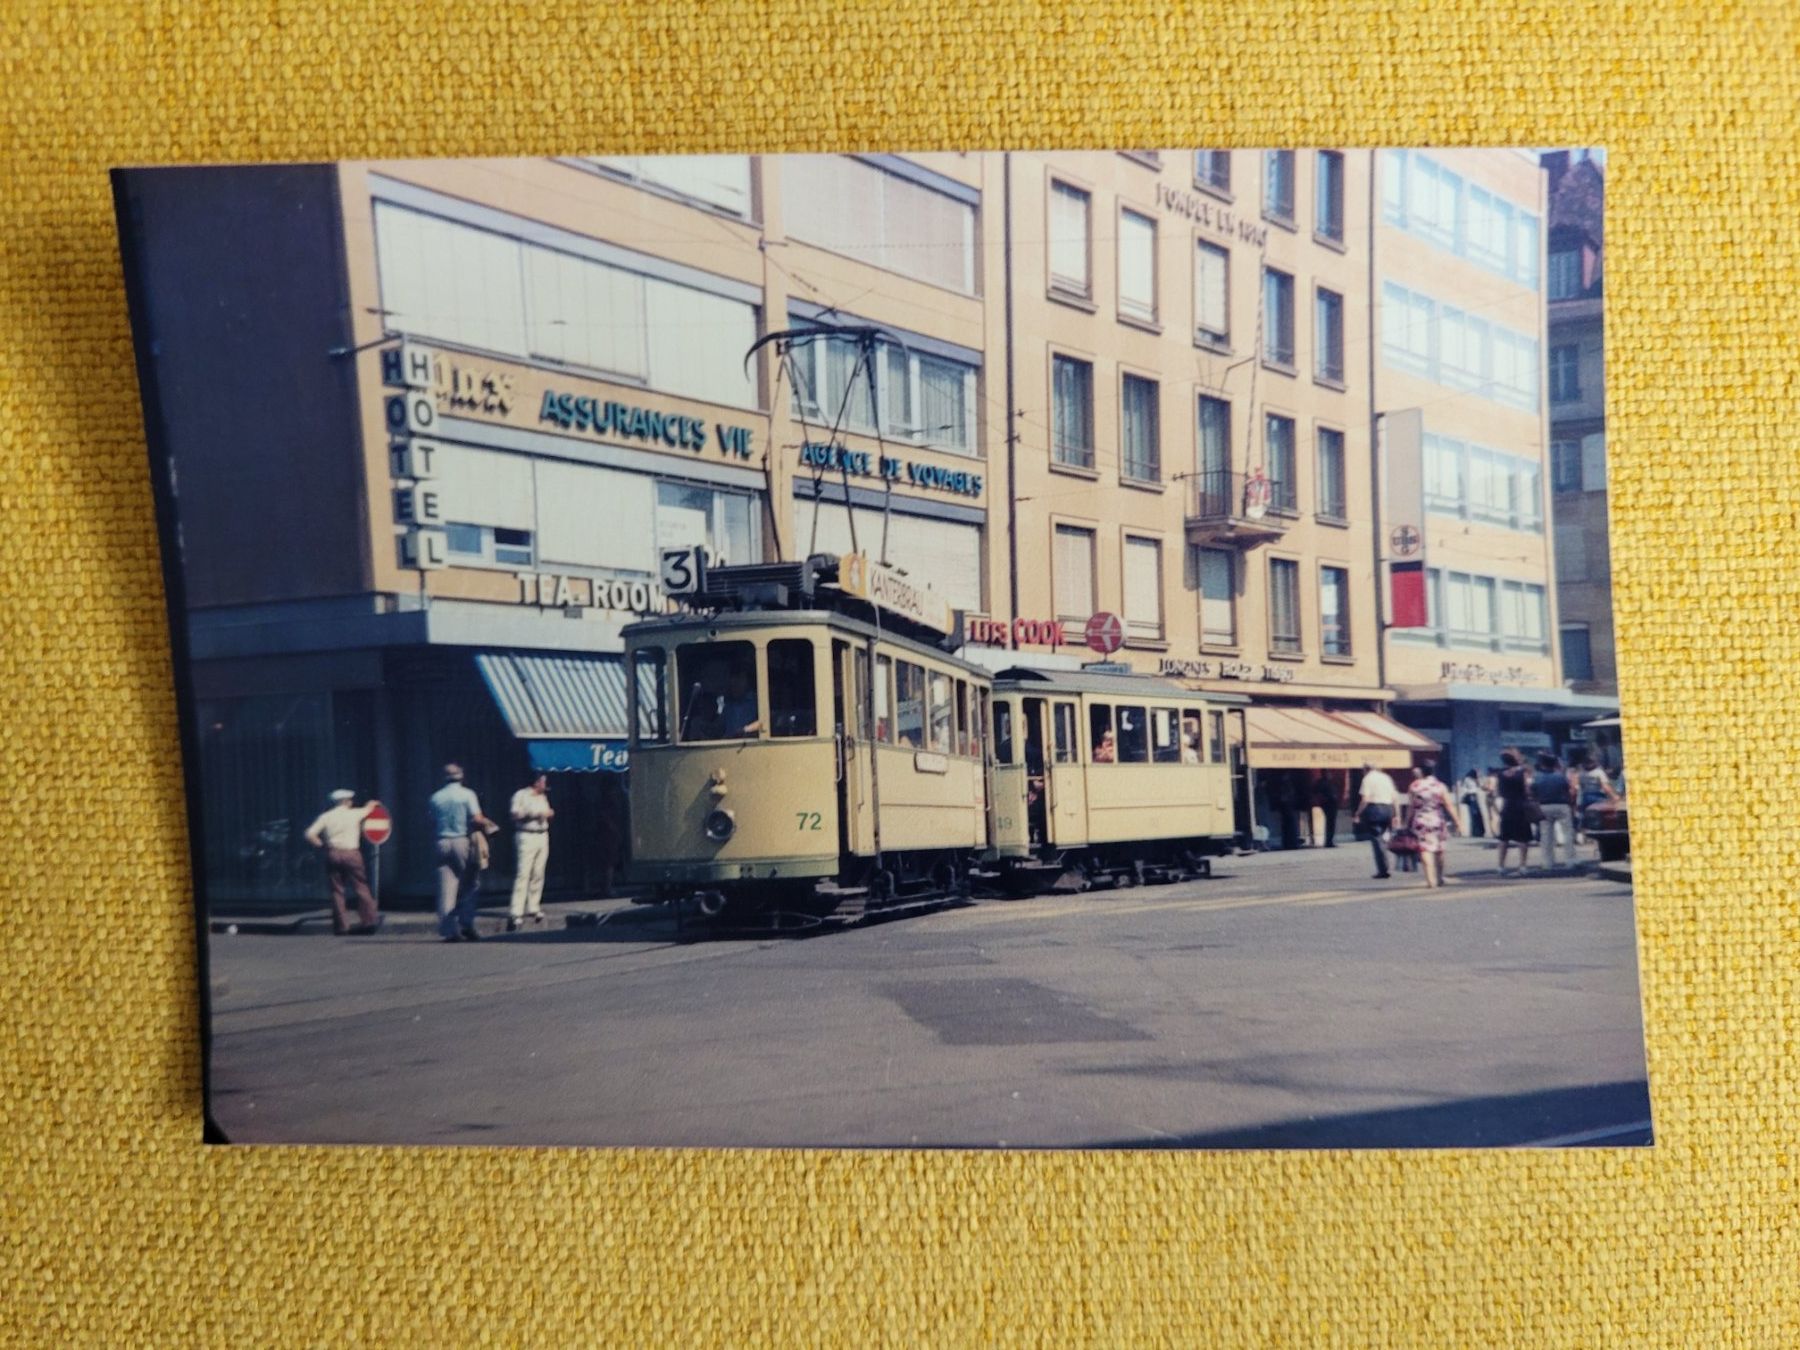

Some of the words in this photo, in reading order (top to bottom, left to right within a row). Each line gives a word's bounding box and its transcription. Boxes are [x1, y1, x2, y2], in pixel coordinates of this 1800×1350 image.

[540, 389, 706, 453] ASSURANCES
[716, 423, 754, 460] VIE
[410, 353, 443, 565] HOTEL
[879, 455, 903, 481] DE
[907, 462, 983, 499] VOYAGES
[662, 550, 693, 590] 3
[1013, 616, 1068, 648] COOK
[590, 743, 630, 766] Tea
[796, 812, 822, 831] 72
